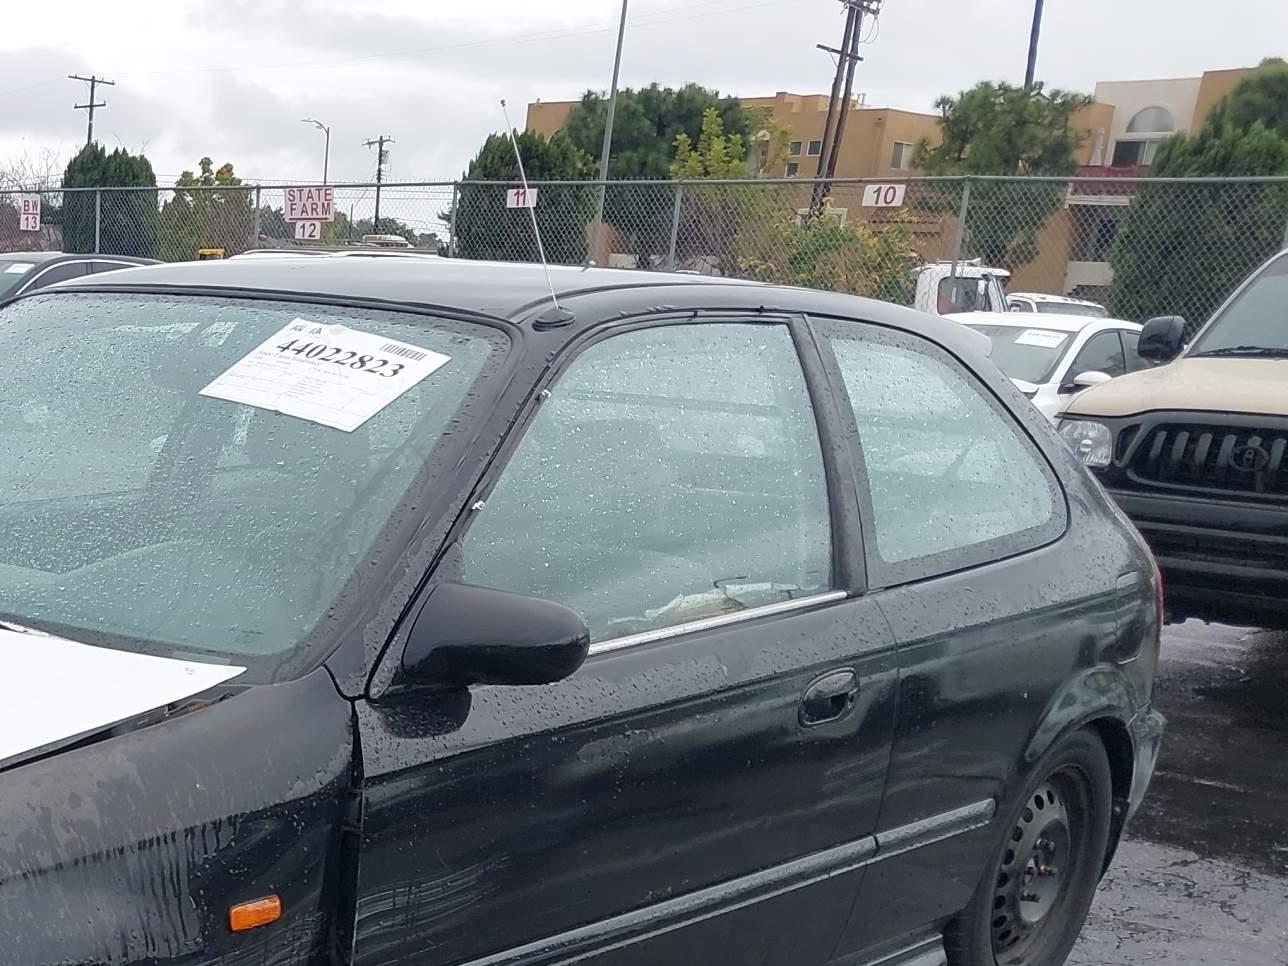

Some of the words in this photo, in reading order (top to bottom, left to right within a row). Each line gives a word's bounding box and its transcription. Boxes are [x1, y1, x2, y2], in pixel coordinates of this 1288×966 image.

[287, 188, 333, 202] STATE
[514, 190, 526, 206] 11
[873, 186, 897, 206] 10
[23, 200, 39, 212] BW
[290, 202, 331, 217] FARM
[24, 216, 38, 230] 13
[299, 222, 317, 238] 12
[275, 339, 406, 378] 44022823
